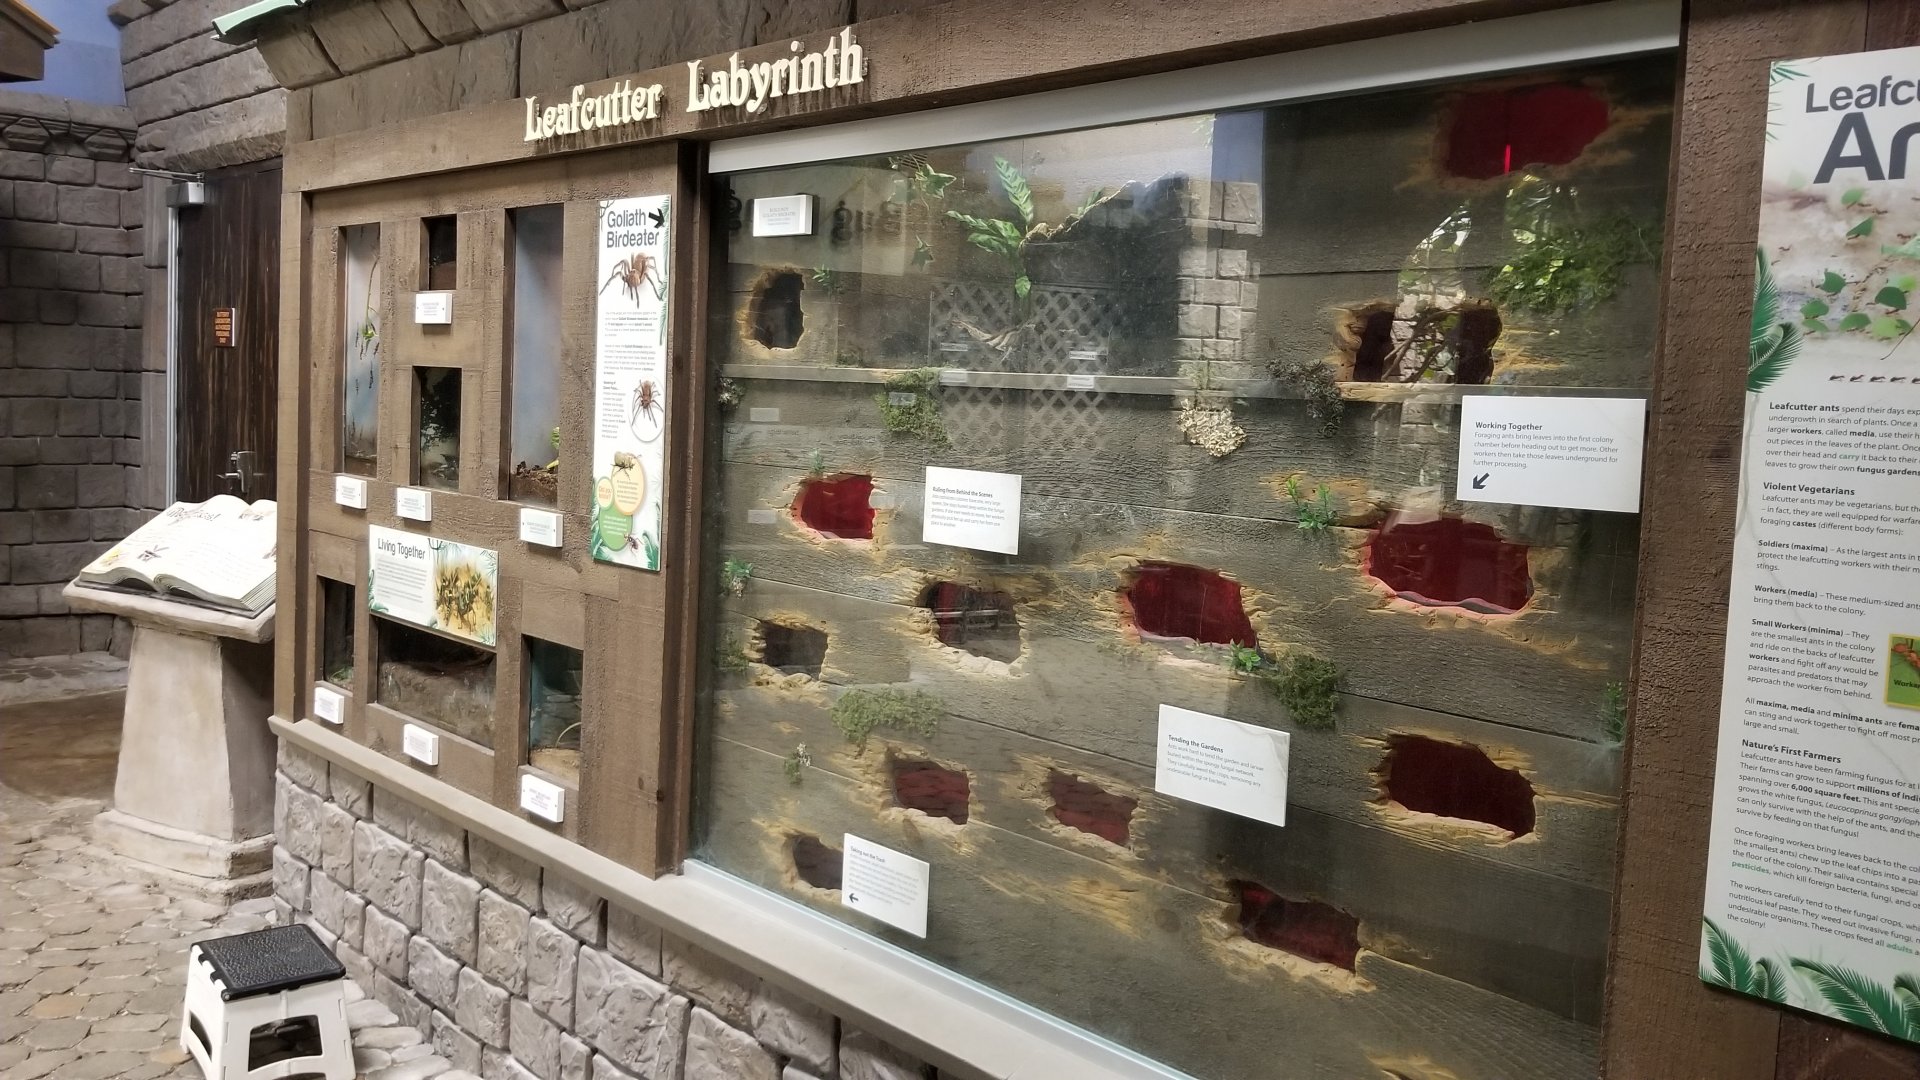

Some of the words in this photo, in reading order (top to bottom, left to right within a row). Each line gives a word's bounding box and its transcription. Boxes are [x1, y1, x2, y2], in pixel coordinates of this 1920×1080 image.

[523, 79, 664, 142] Leafcutter
[685, 25, 866, 114] Labyrinth
[1806, 75, 1920, 113] Leafc
[607, 208, 647, 229] Goliath
[606, 228, 660, 249] Birdeater
[1769, 401, 1818, 411] Leafcutter
[1819, 404, 1840, 412] ants
[1841, 406, 1865, 414] spend
[1866, 406, 1886, 414] their
[1886, 407, 1905, 416] days
[1475, 421, 1507, 431] Working
[1508, 422, 1543, 431] Together
[1768, 414, 1817, 424] undergrowth
[1827, 417, 1852, 425] search
[1853, 417, 1862, 425] of
[1862, 418, 1889, 426] plants.
[1890, 419, 1912, 427] Once
[1474, 432, 1501, 440] Foraging
[1515, 433, 1532, 441] bring
[1591, 436, 1614, 444] colony
[1767, 425, 1789, 435] larger
[1790, 427, 1824, 435] workers,
[1825, 428, 1848, 436] called
[1849, 429, 1877, 438] media,
[1894, 431, 1913, 440] their
[1473, 450, 1497, 458] workers
[1565, 455, 1608, 463] underground
[1521, 443, 1547, 451] heading
[1567, 445, 1579, 453] get
[1473, 459, 1493, 467] further
[1494, 460, 1528, 469] processing.
[1763, 481, 1797, 492] Violent
[1798, 484, 1855, 496] Vegetarians
[1762, 494, 1799, 503] Leafcutter
[1800, 497, 1816, 505] ants
[1817, 499, 1834, 507] may
[1835, 499, 1846, 507] be
[1894, 504, 1909, 512] but
[1775, 506, 1792, 515] fact,
[1793, 508, 1810, 517] they
[1841, 512, 1879, 522] equipped
[1880, 514, 1892, 522] for
[1760, 516, 1791, 527] foraging
[1792, 520, 1817, 528] castes
[1818, 521, 1853, 532] (different
[1854, 524, 1875, 535] body
[377, 537, 396, 556] Living
[397, 542, 426, 560] Together
[1758, 539, 1790, 549] Soldiers
[1791, 542, 1828, 553] (maxima)
[1836, 546, 1846, 555] As
[1847, 547, 1860, 556] the
[1861, 549, 1888, 559] largest
[1889, 552, 1906, 560] ants
[1756, 562, 1780, 572] stings.
[1757, 551, 1784, 561] protect
[1785, 553, 1798, 561] the
[1799, 554, 1840, 567] leafcutting
[1840, 559, 1871, 569] workers
[1872, 562, 1890, 570] with
[1891, 563, 1911, 572] their
[1754, 584, 1787, 595] Workers
[1787, 588, 1818, 599] (media)
[1825, 592, 1848, 602] These
[1753, 596, 1773, 606] bring
[1774, 598, 1794, 607] them
[1795, 600, 1813, 610] back
[1814, 603, 1823, 611] to
[1824, 604, 1837, 613] the
[1838, 606, 1867, 617] colony.
[1751, 618, 1773, 628] Small
[1774, 621, 1807, 632] Workers
[1807, 625, 1844, 637] (minima)
[1851, 630, 1870, 641] They
[1749, 653, 1780, 663] workers
[1780, 657, 1796, 665] and
[1796, 658, 1815, 668] fight
[1815, 661, 1827, 670] off
[1827, 663, 1842, 673] any
[1842, 666, 1867, 676] would
[1868, 669, 1879, 677] be
[1747, 675, 1781, 686] approach
[1782, 680, 1795, 688] the
[1796, 683, 1823, 692] worker
[1823, 685, 1842, 695] from
[1843, 688, 1873, 700] behind.
[1745, 696, 1755, 704] All
[1756, 699, 1789, 710] maxima,
[1790, 705, 1815, 714] media
[1816, 709, 1831, 717] and
[1832, 711, 1863, 722] minima
[1864, 717, 1883, 725] ants
[1168, 734, 1190, 746] Tending
[1190, 739, 1200, 747] the
[1200, 742, 1224, 753] Gardens
[1780, 745, 1802, 757] First
[1803, 749, 1842, 764] Farmers
[1738, 774, 1772, 786] spanning
[1791, 783, 1813, 793] 6,000
[1814, 787, 1842, 799] square
[1842, 793, 1862, 803] feet.
[1727, 913, 1739, 921] the
[1740, 917, 1767, 929] colony!
